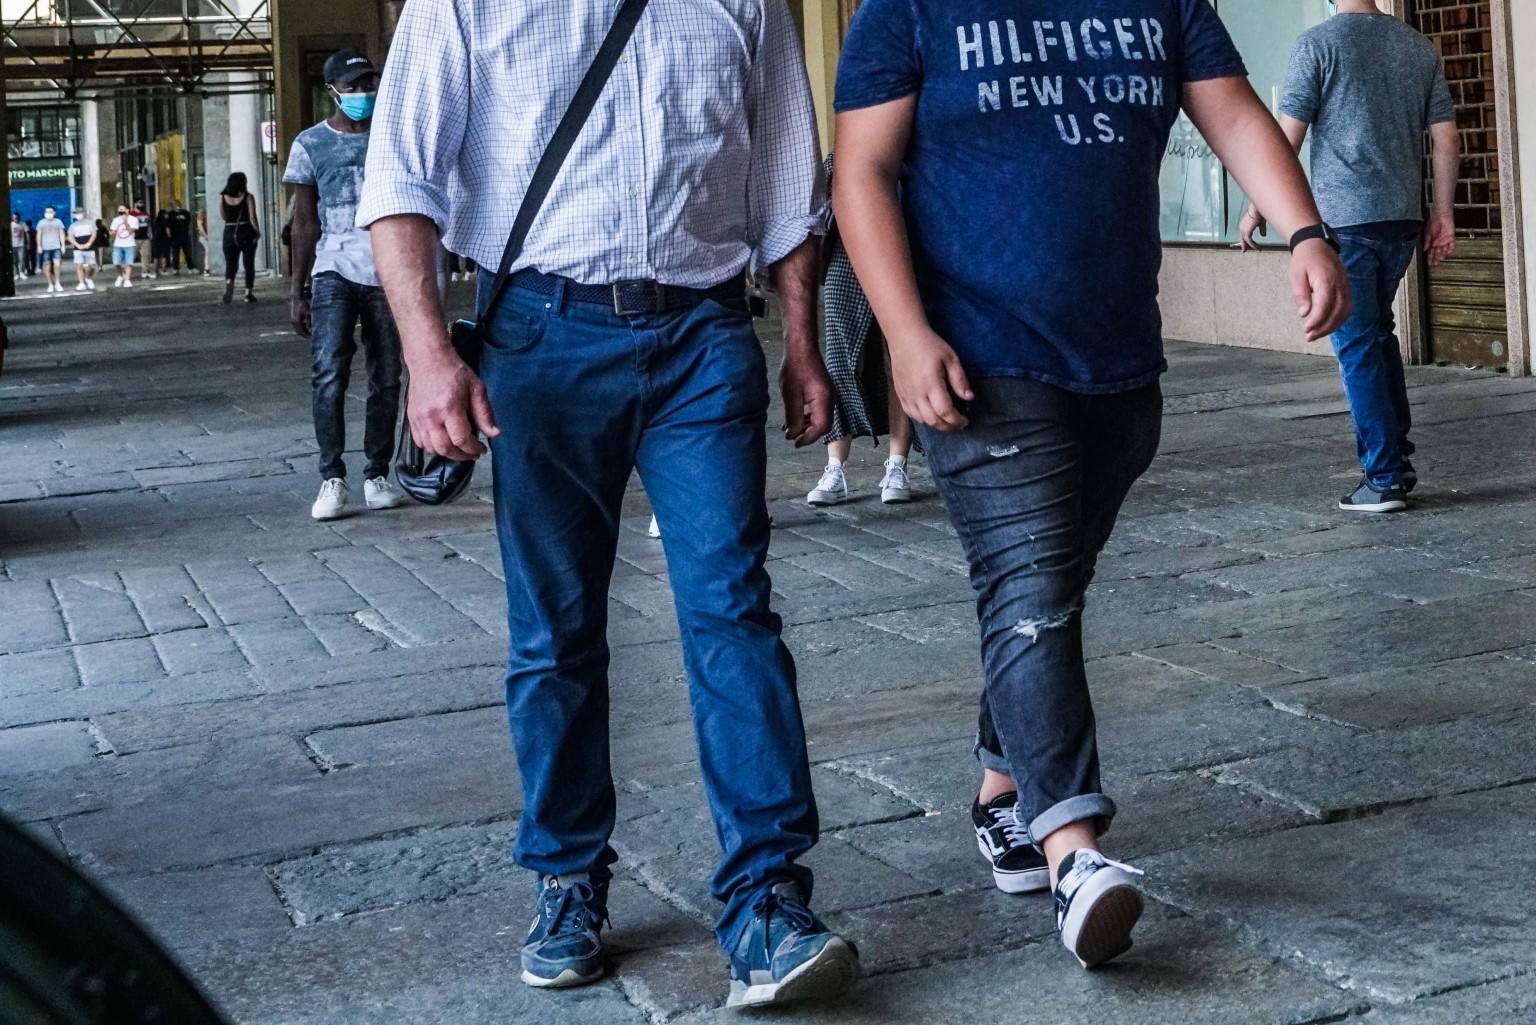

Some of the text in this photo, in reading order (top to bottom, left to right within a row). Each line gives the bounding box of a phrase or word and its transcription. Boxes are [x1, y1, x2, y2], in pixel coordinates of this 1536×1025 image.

[956, 17, 1168, 71] HILFIGER
[977, 75, 1063, 113] NEW
[1053, 112, 1125, 145] U.S.
[27, 167, 81, 179] MARCHETTI
